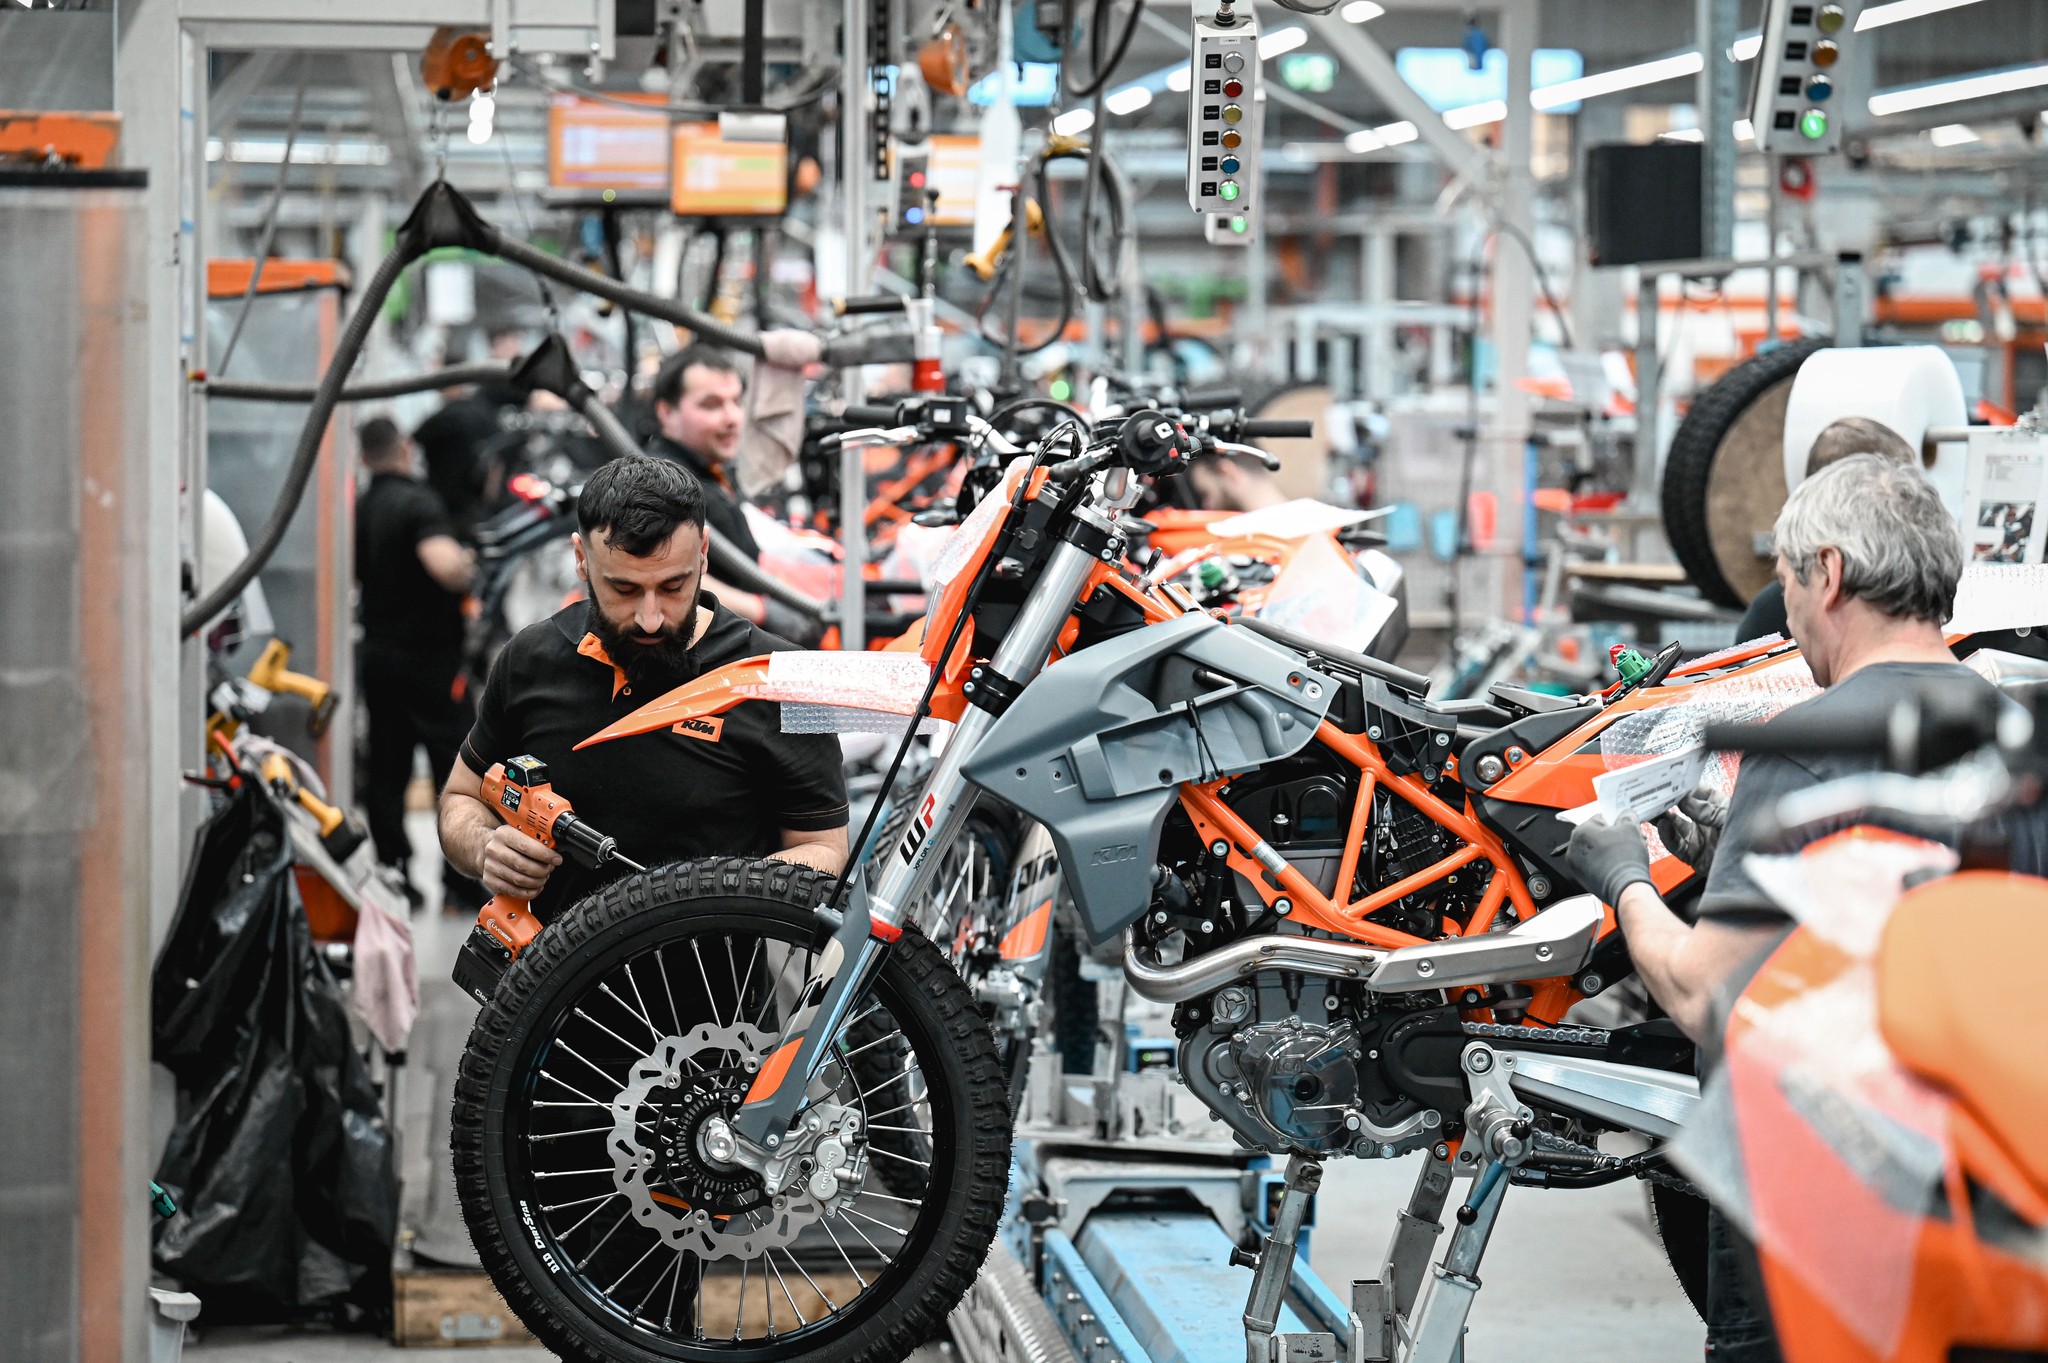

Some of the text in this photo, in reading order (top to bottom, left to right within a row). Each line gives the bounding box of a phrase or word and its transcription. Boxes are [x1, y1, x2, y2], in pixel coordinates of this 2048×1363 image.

[680, 719, 716, 736] KTM
[899, 792, 936, 866] WP
[1090, 843, 1138, 867] KTM
[820, 1150, 838, 1191] brembo
